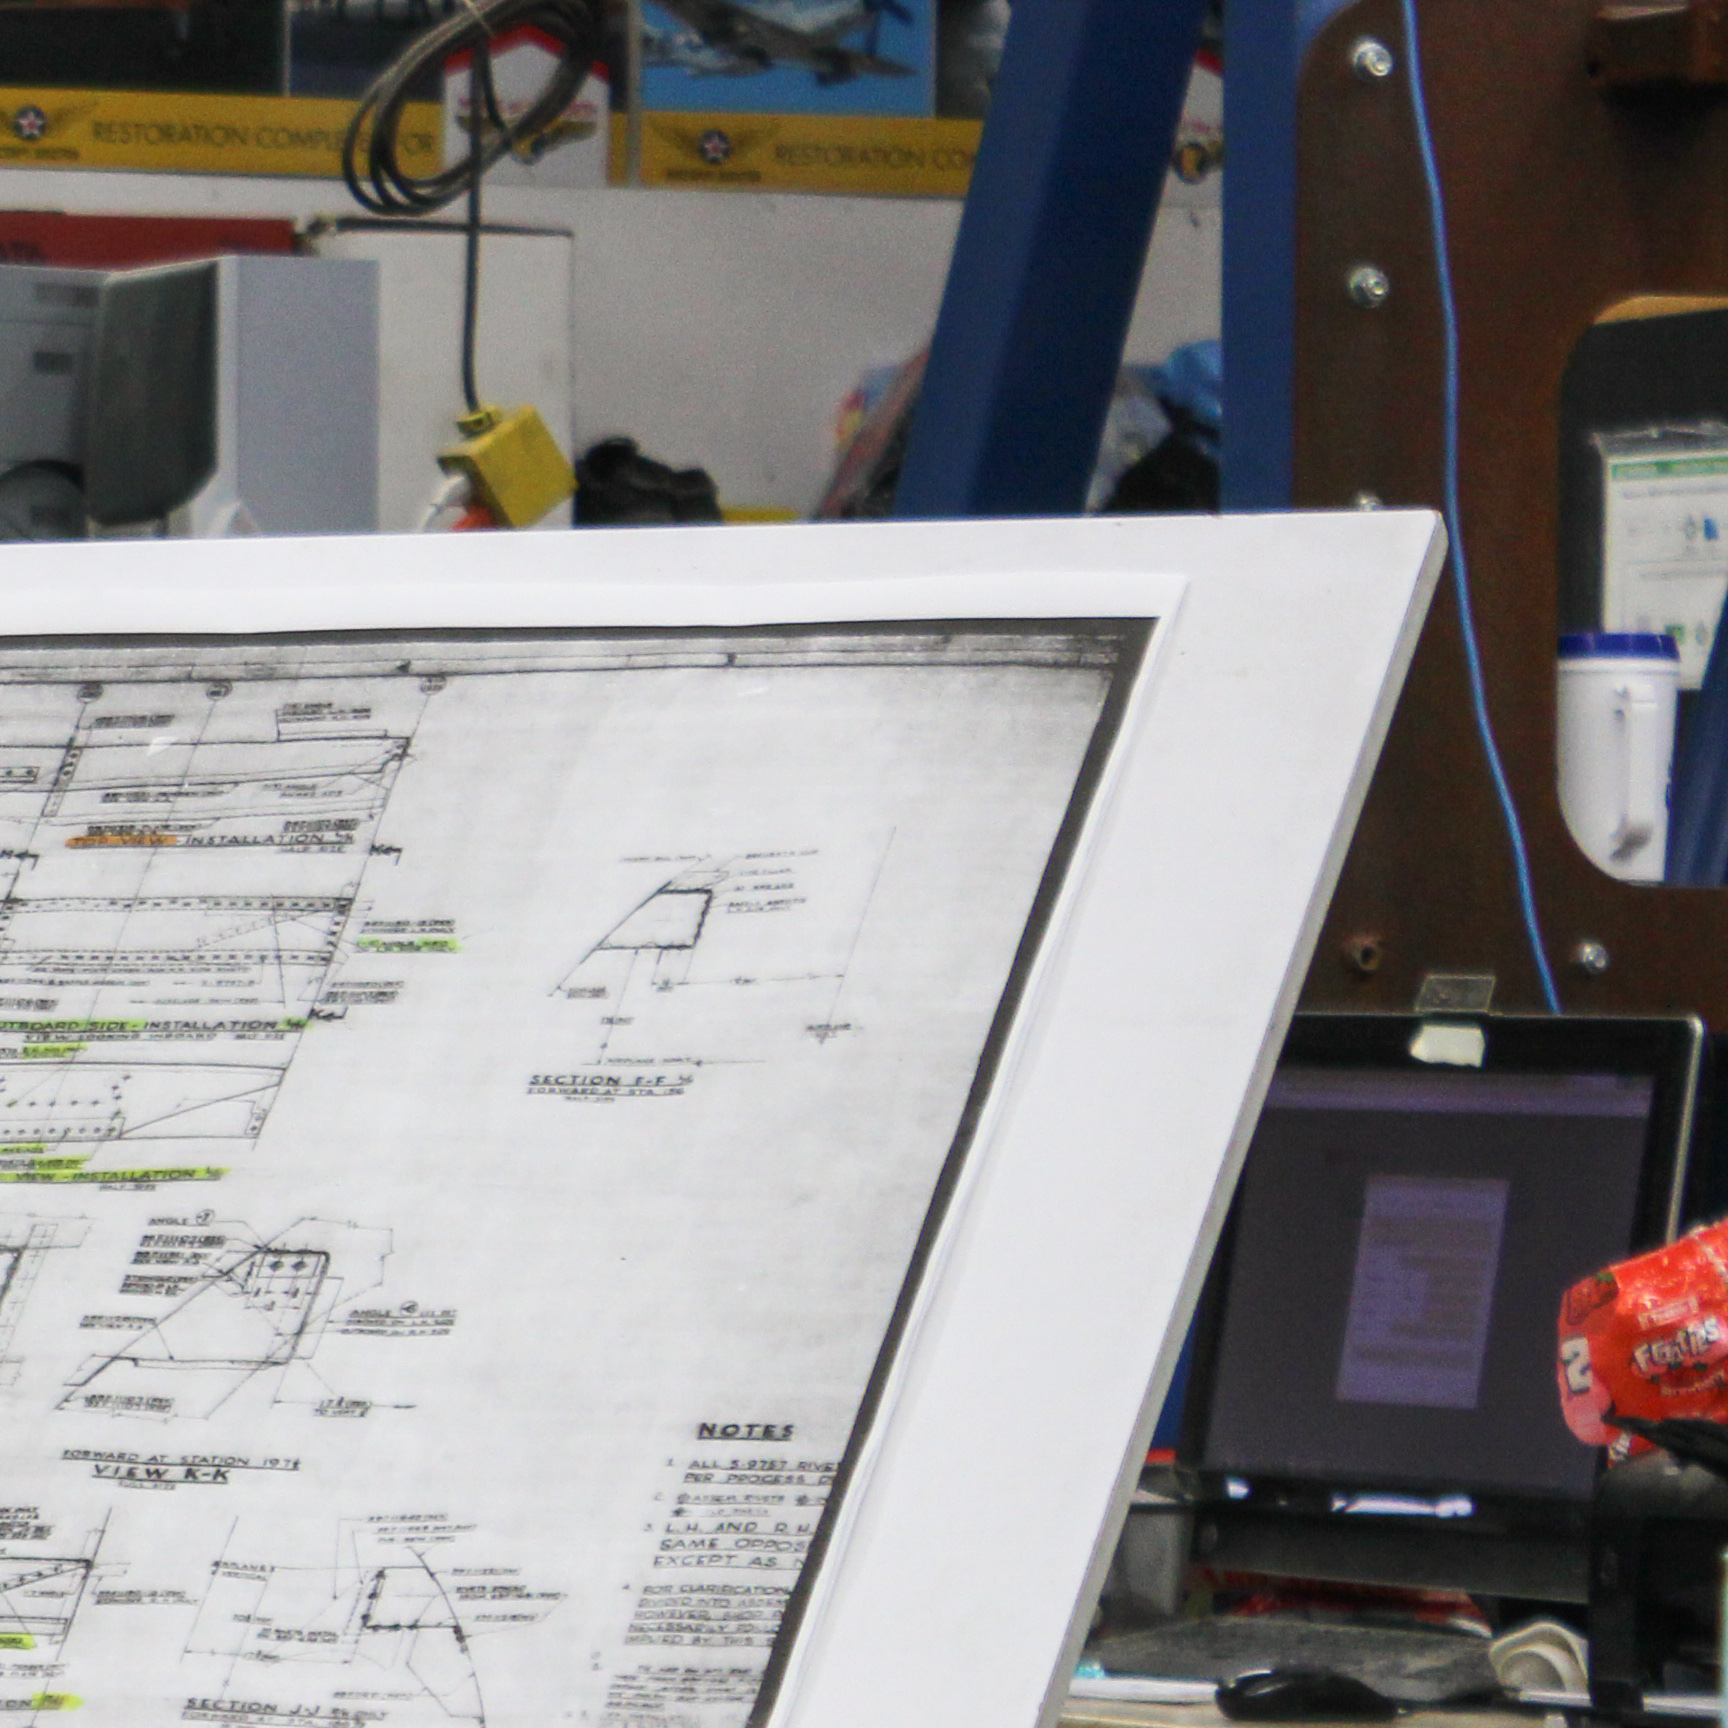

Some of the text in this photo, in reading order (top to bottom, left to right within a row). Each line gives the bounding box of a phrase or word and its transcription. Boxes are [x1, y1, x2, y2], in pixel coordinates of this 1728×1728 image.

[93, 121, 248, 147] RESTORATION
[775, 143, 924, 169] RESTORATION
[73, 836, 105, 847] TOP
[120, 836, 165, 847] VIEW
[530, 1074, 667, 1087] SECTION F-F
[697, 1422, 795, 1440] NOTES
[61, 1449, 251, 1467] FORWARD AT STATION
[688, 1459, 720, 1470] ALL
[93, 1463, 232, 1482] VIEW K-K
[683, 1473, 806, 1485] PER PROCESS
[714, 1521, 758, 1533] AND
[659, 1538, 720, 1550] SAME
[652, 1555, 738, 1569] EXCEPT
[748, 1556, 778, 1568] AS
[184, 1697, 279, 1713] SECTION
